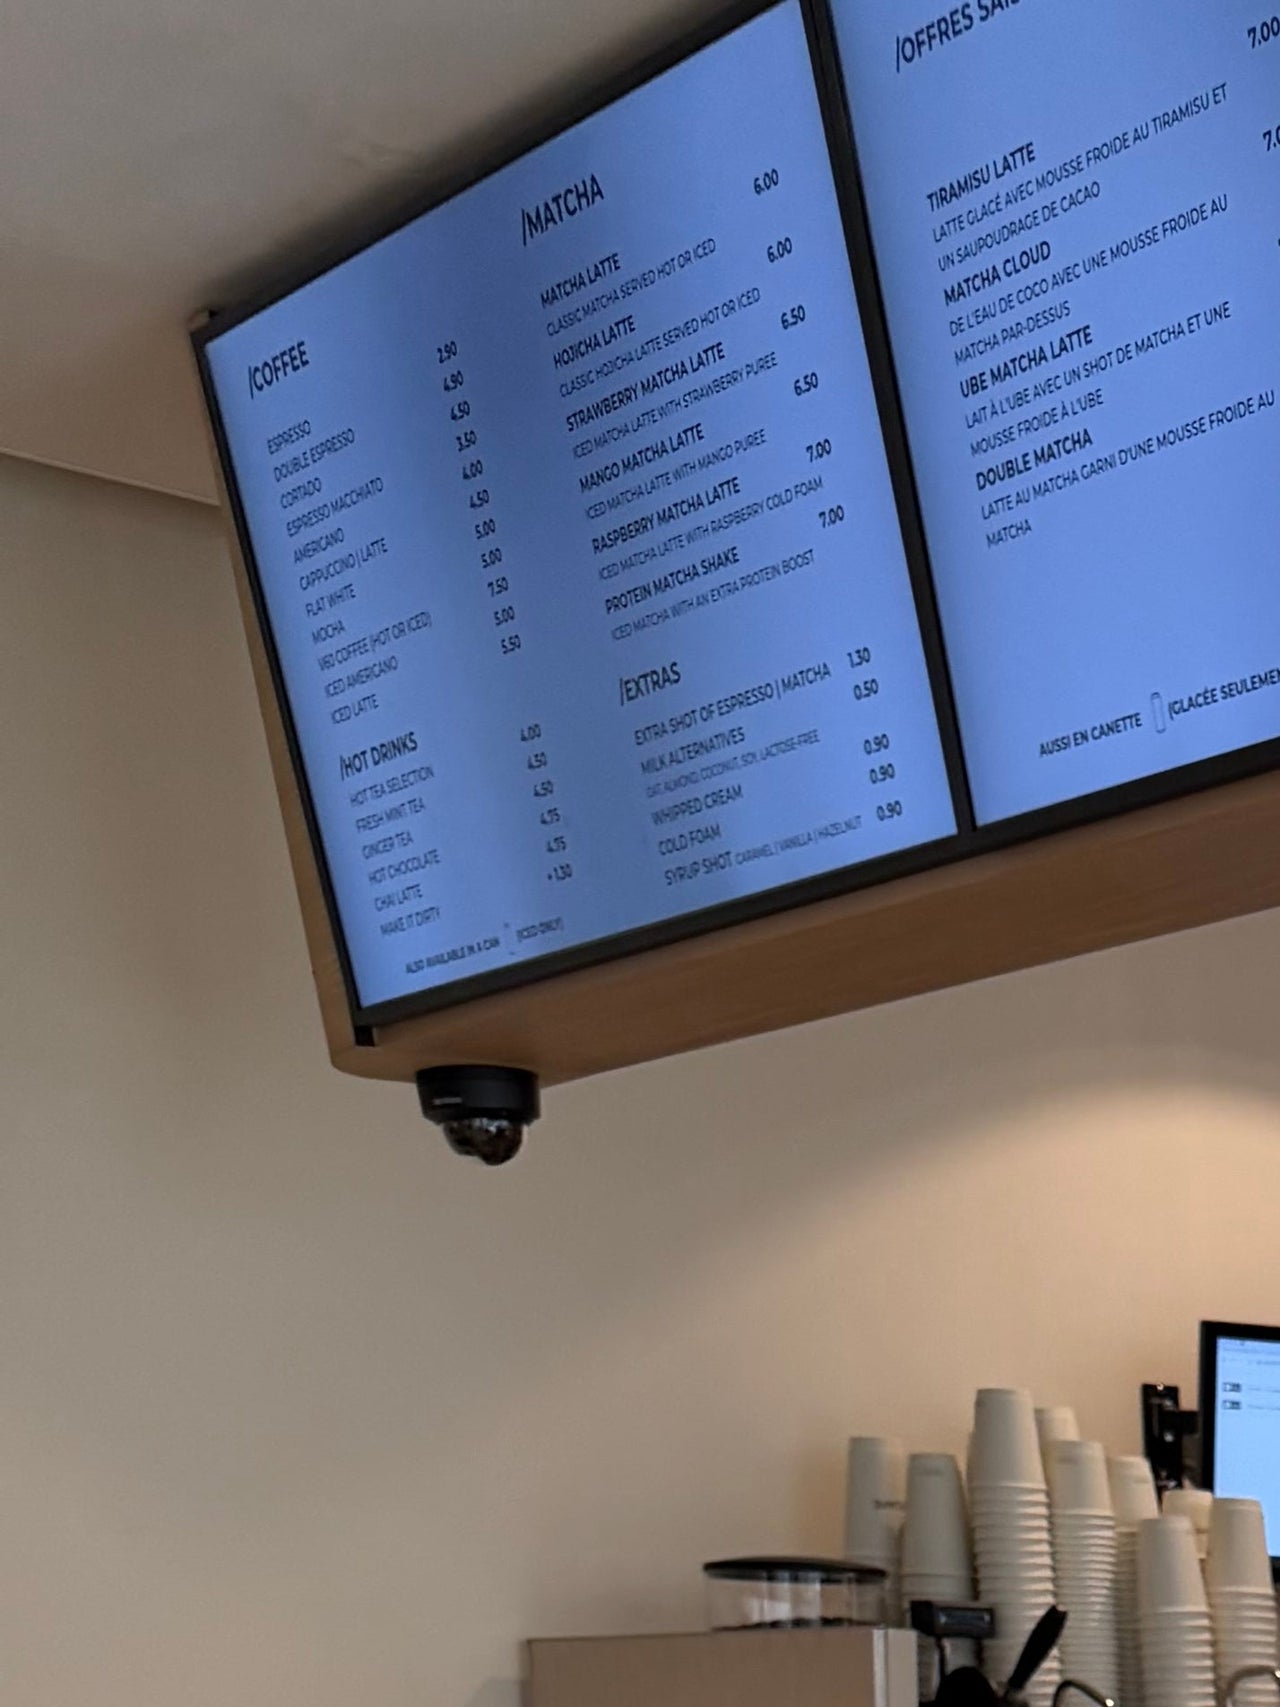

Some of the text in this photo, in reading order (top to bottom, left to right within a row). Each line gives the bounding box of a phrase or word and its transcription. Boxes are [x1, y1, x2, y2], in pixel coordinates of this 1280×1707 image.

[896, 3, 975, 74] /OFFRES
[1246, 15, 1280, 49] 7.00
[752, 167, 779, 195] 6.00
[925, 141, 1036, 212] TIRAMISU LATTE
[932, 81, 1226, 243] LATTE GLACÉ AVEC MOUSSE FROIDE AU TIRAMISU ET
[520, 173, 604, 246] /MATCHA
[937, 180, 1100, 272] UN SAUPOUDRAGE DE CACAO
[539, 251, 621, 308] MATCHA LATTE
[766, 236, 792, 263] 6.00
[943, 240, 1051, 306] MATCHA CLOUD
[948, 193, 1227, 337] DE L'EAU DE COCO AVEC UNE MOUSSE FROIDE AU
[552, 313, 636, 369] HOJICHA LATTE
[780, 304, 806, 330] 6.50
[953, 299, 1070, 365] MATCHA PAR-DESSUS
[247, 340, 310, 399] /COFFEE
[565, 340, 726, 432] STRAWBERRY MATCHA LATTE
[793, 371, 818, 396] 6.50
[959, 323, 1093, 398] UBE MATCHA LATTE
[965, 300, 1231, 429] LAIT À L'UBE AVEC UN SHOT DE MATCHA ET UNE
[805, 437, 832, 463] 7.00
[969, 387, 1104, 456] MOUSSE FROIDE À L'UBE
[980, 389, 1275, 520] LATTE AU MATCHA GARNI D'UNE MOUSSE FROIDE AU
[578, 421, 705, 492] MANGO MATCHA LATTE
[975, 427, 1093, 491] DOUBLE MATCHA
[591, 475, 741, 554] RASPBERRY MATCHA LATTE
[817, 504, 844, 528] 7.00
[985, 518, 1032, 548] MATCHA
[604, 545, 740, 614] PROTEIN MATCHA SHAKE
[618, 660, 681, 706] /EXTRAS
[1039, 734, 1071, 758] AUSSI
[1073, 729, 1089, 747] EN
[1091, 712, 1143, 741] CANETTE
[1167, 685, 1219, 721] (GLACÉE
[339, 730, 418, 781] /HOT DRINKS
